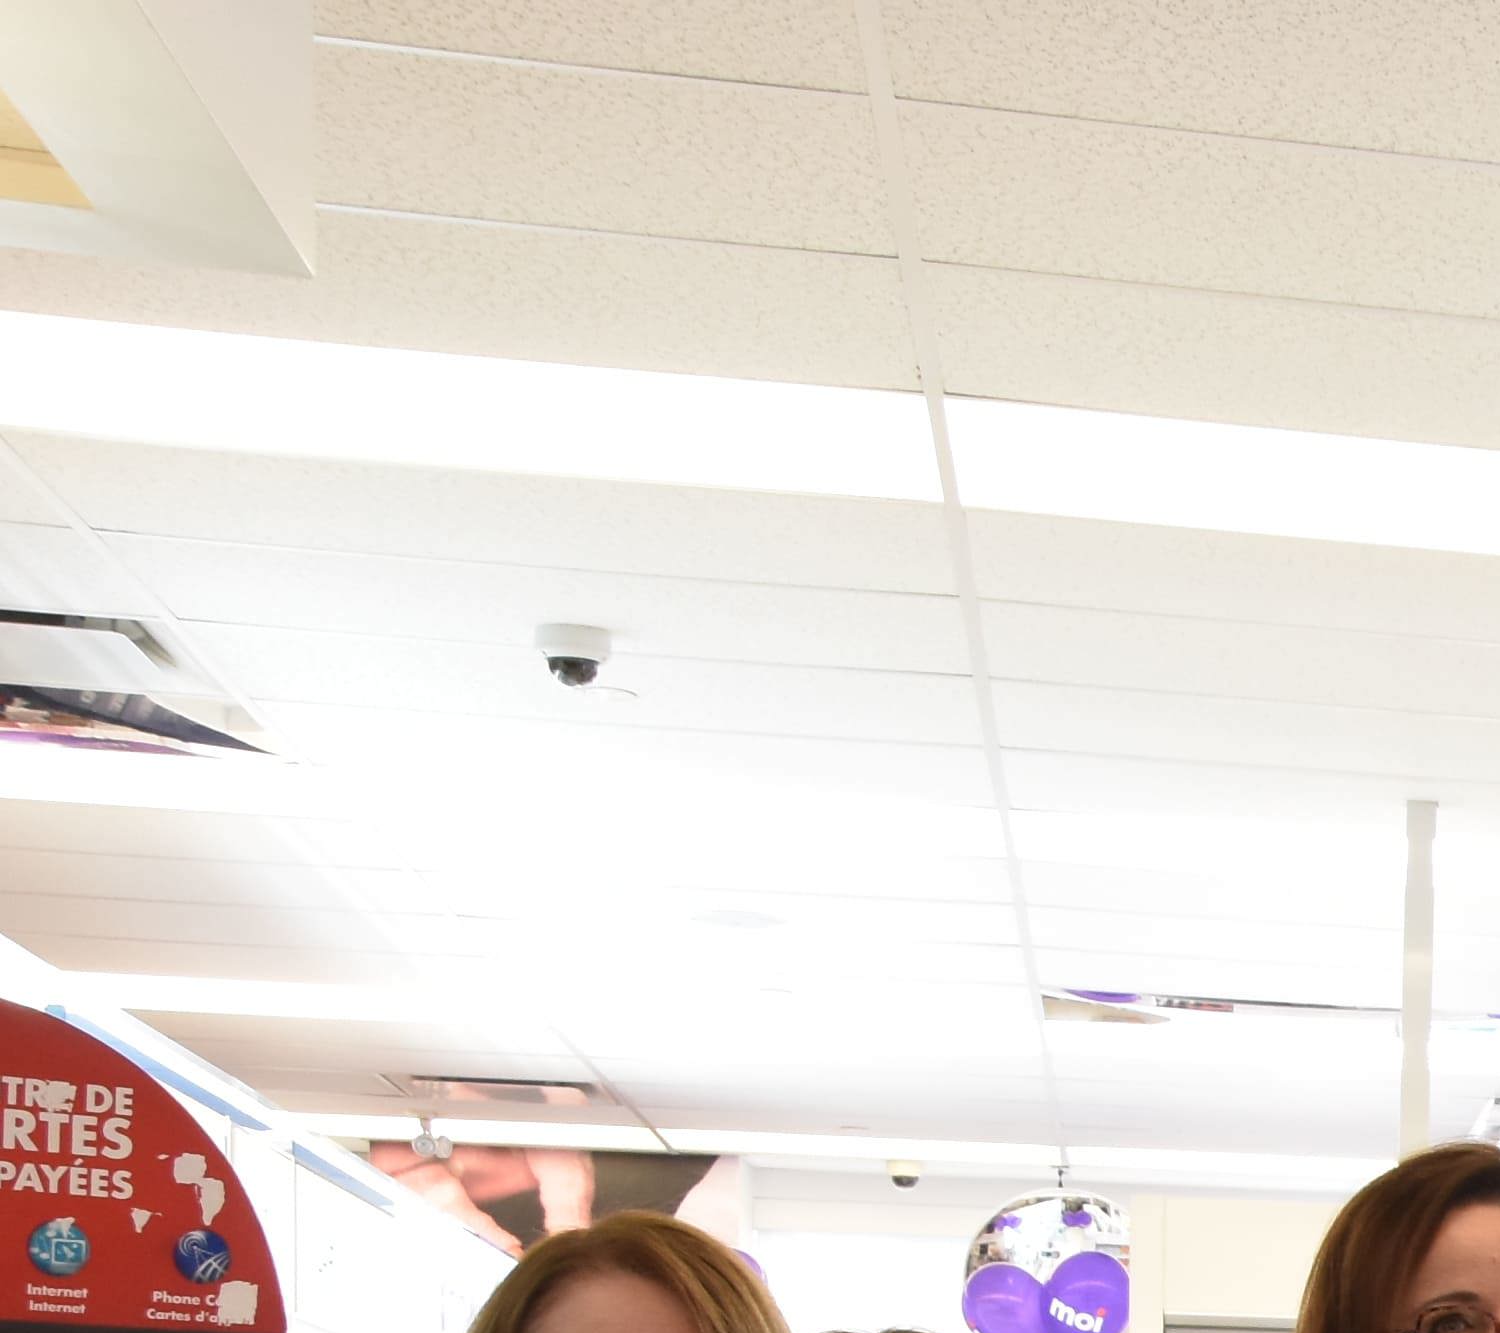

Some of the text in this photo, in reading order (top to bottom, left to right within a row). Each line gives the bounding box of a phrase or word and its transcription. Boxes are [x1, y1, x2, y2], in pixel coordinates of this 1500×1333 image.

[86, 1084, 134, 1116] DE
[3, 1109, 133, 1160] RTES
[0, 1158, 134, 1200] PAYÉES
[27, 1283, 88, 1299] Internet
[153, 1291, 200, 1307] Phone
[29, 1299, 86, 1315] Internet
[147, 1308, 191, 1323] Cartes
[1049, 1297, 1107, 1333] moi
